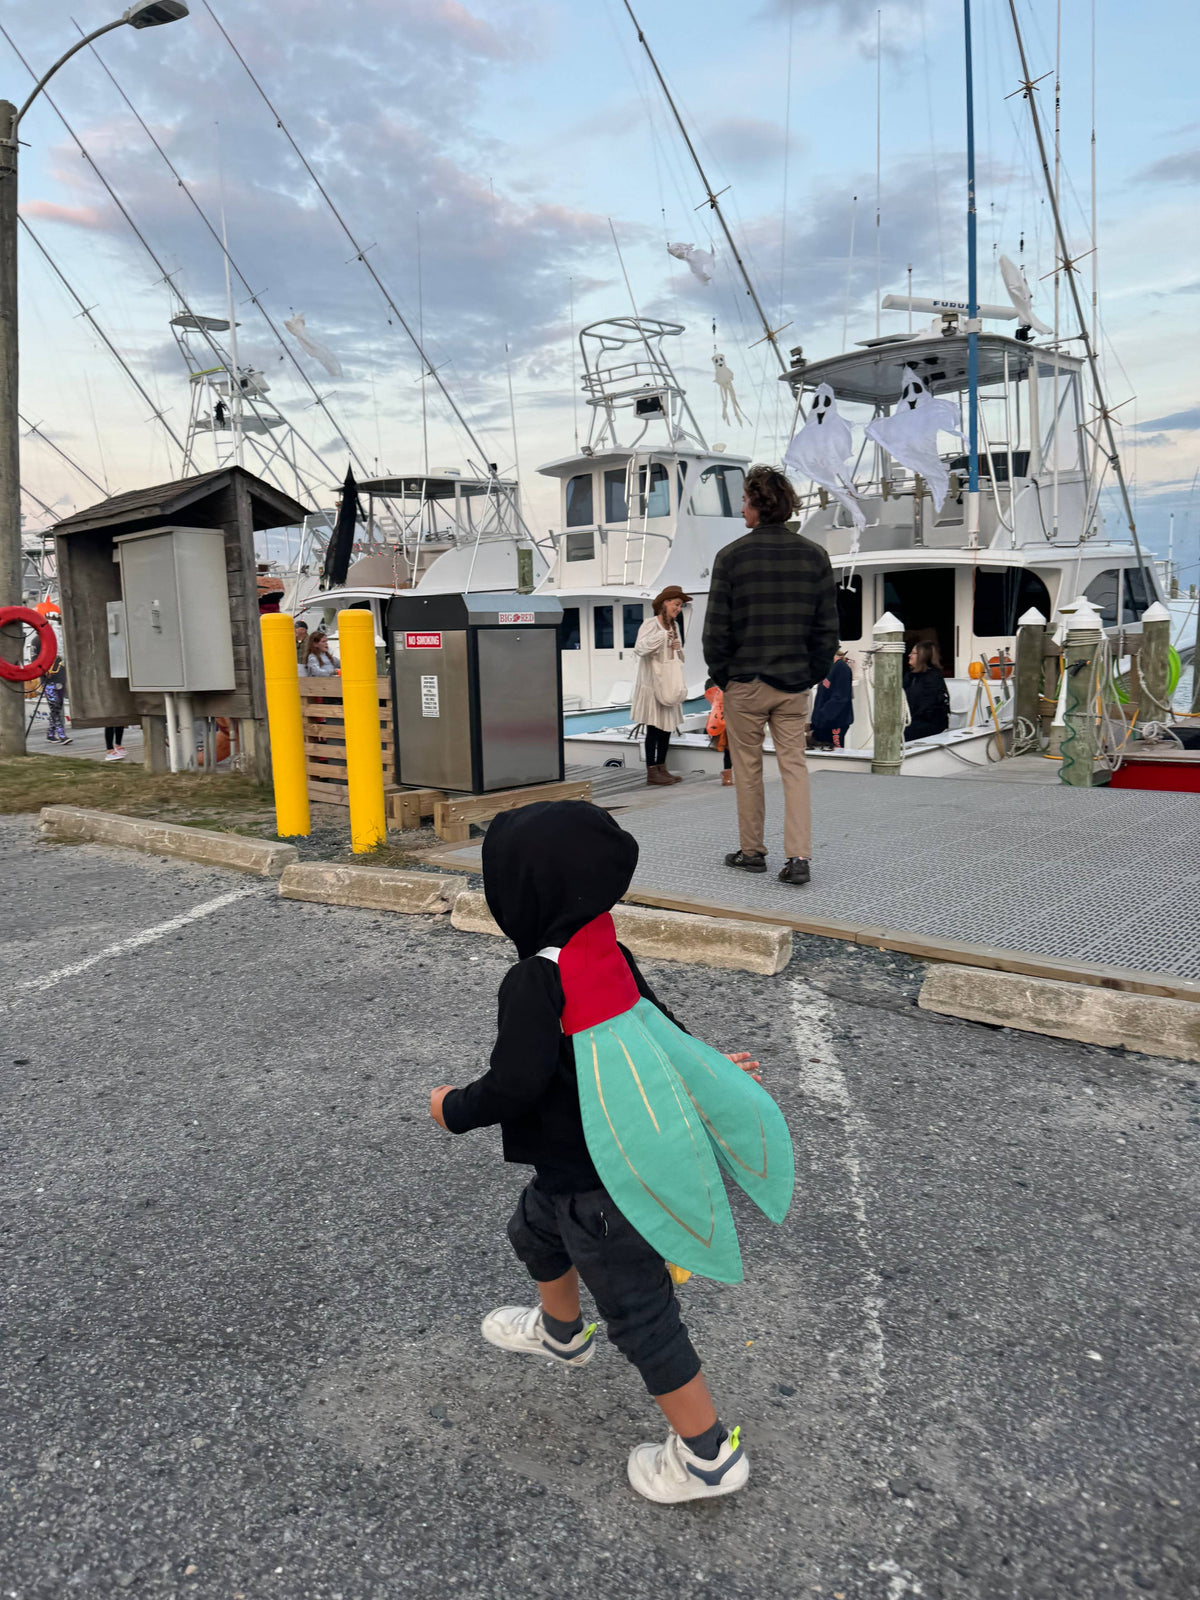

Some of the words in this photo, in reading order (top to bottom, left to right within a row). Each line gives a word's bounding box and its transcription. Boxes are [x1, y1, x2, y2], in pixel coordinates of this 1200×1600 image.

[499, 613, 512, 622] BIG
[521, 613, 534, 622] RED
[408, 635, 416, 645] NO
[416, 635, 439, 645] SMOKING
